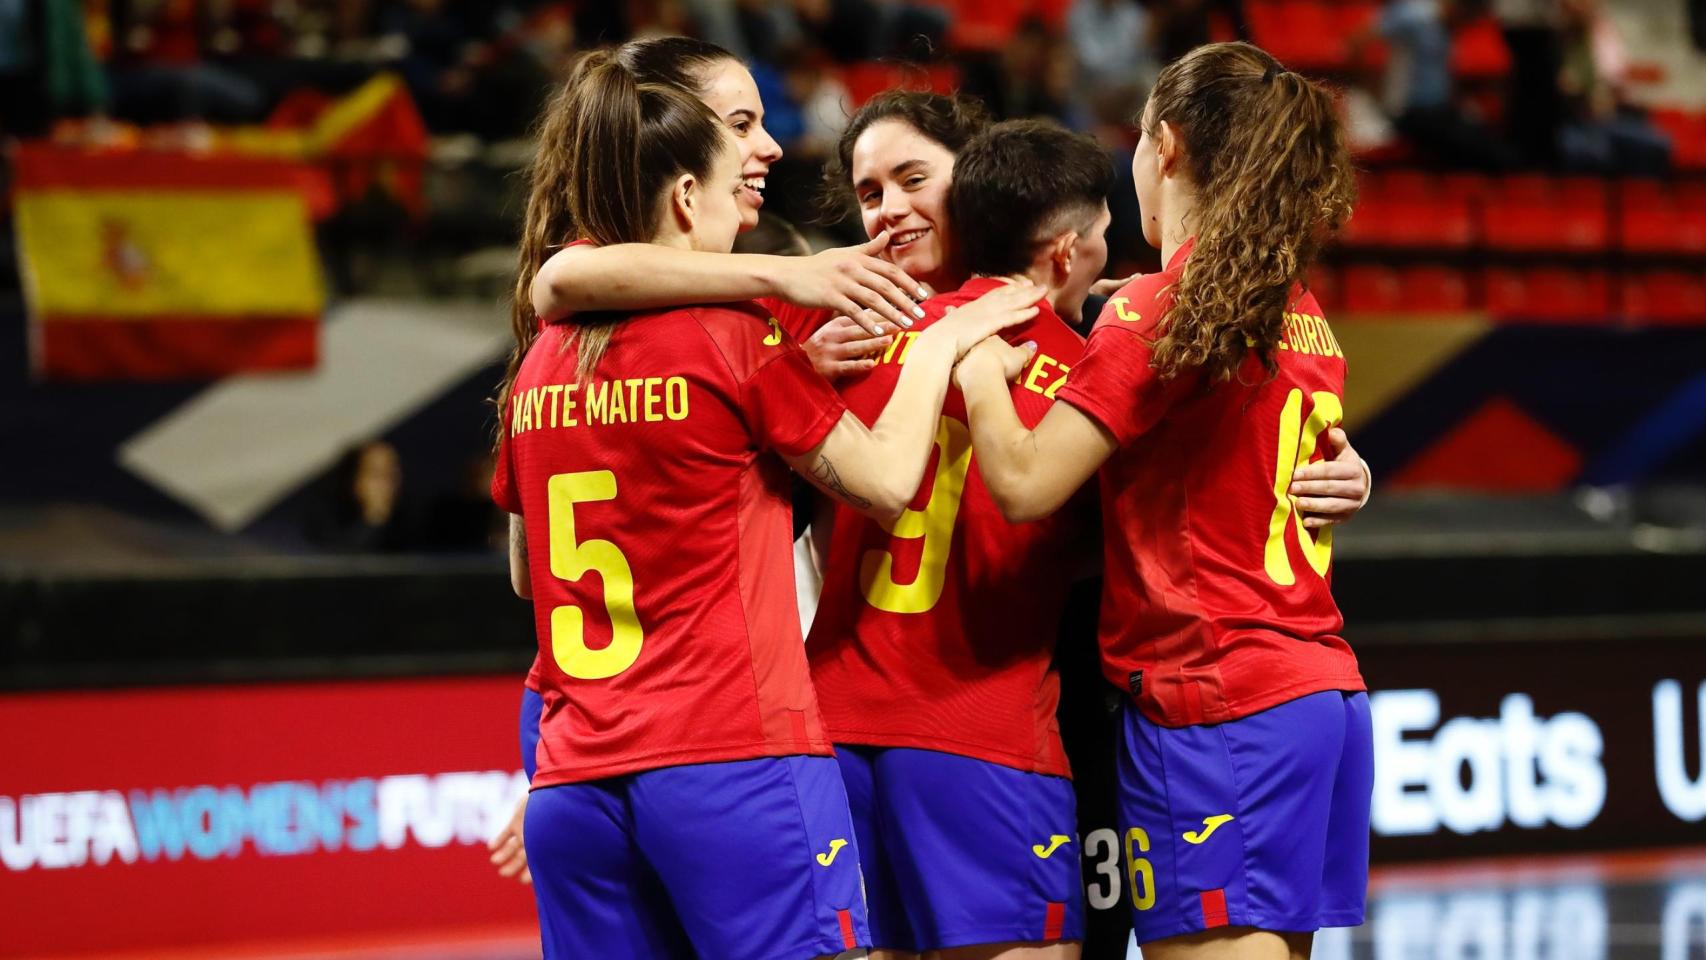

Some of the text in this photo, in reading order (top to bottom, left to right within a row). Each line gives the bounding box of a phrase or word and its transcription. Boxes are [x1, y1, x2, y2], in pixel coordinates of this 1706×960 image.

[512, 376, 689, 438] MAYTE MATEO
[547, 469, 644, 680] 5
[859, 414, 973, 614] 9
[0, 790, 140, 871] UEFA
[1369, 687, 1608, 836] Eats
